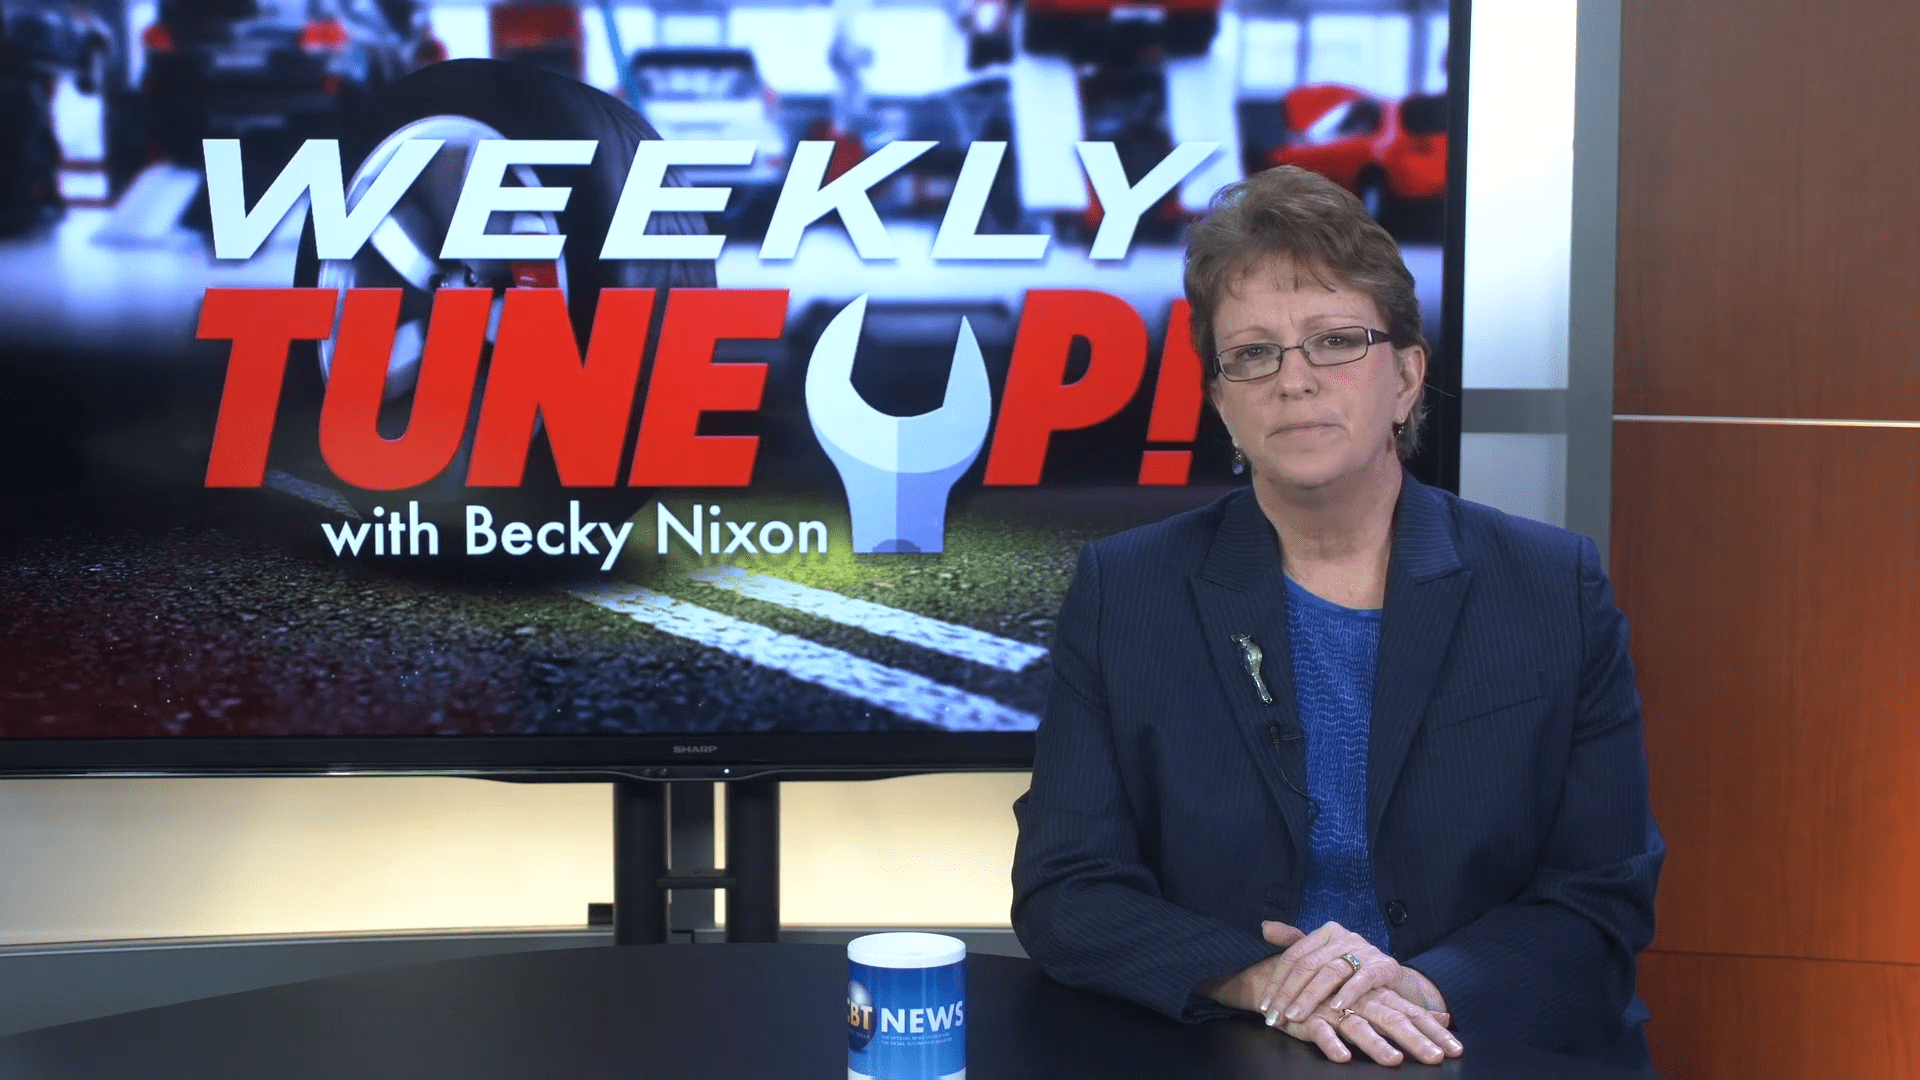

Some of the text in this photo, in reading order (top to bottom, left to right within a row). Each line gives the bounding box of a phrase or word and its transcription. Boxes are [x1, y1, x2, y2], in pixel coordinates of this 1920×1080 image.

[202, 139, 1222, 260] WEEKLY
[195, 287, 790, 490] TUNE
[322, 500, 829, 571] with Becky Nixon
[672, 745, 718, 754] SHARP
[881, 1000, 964, 1034] NEWS
